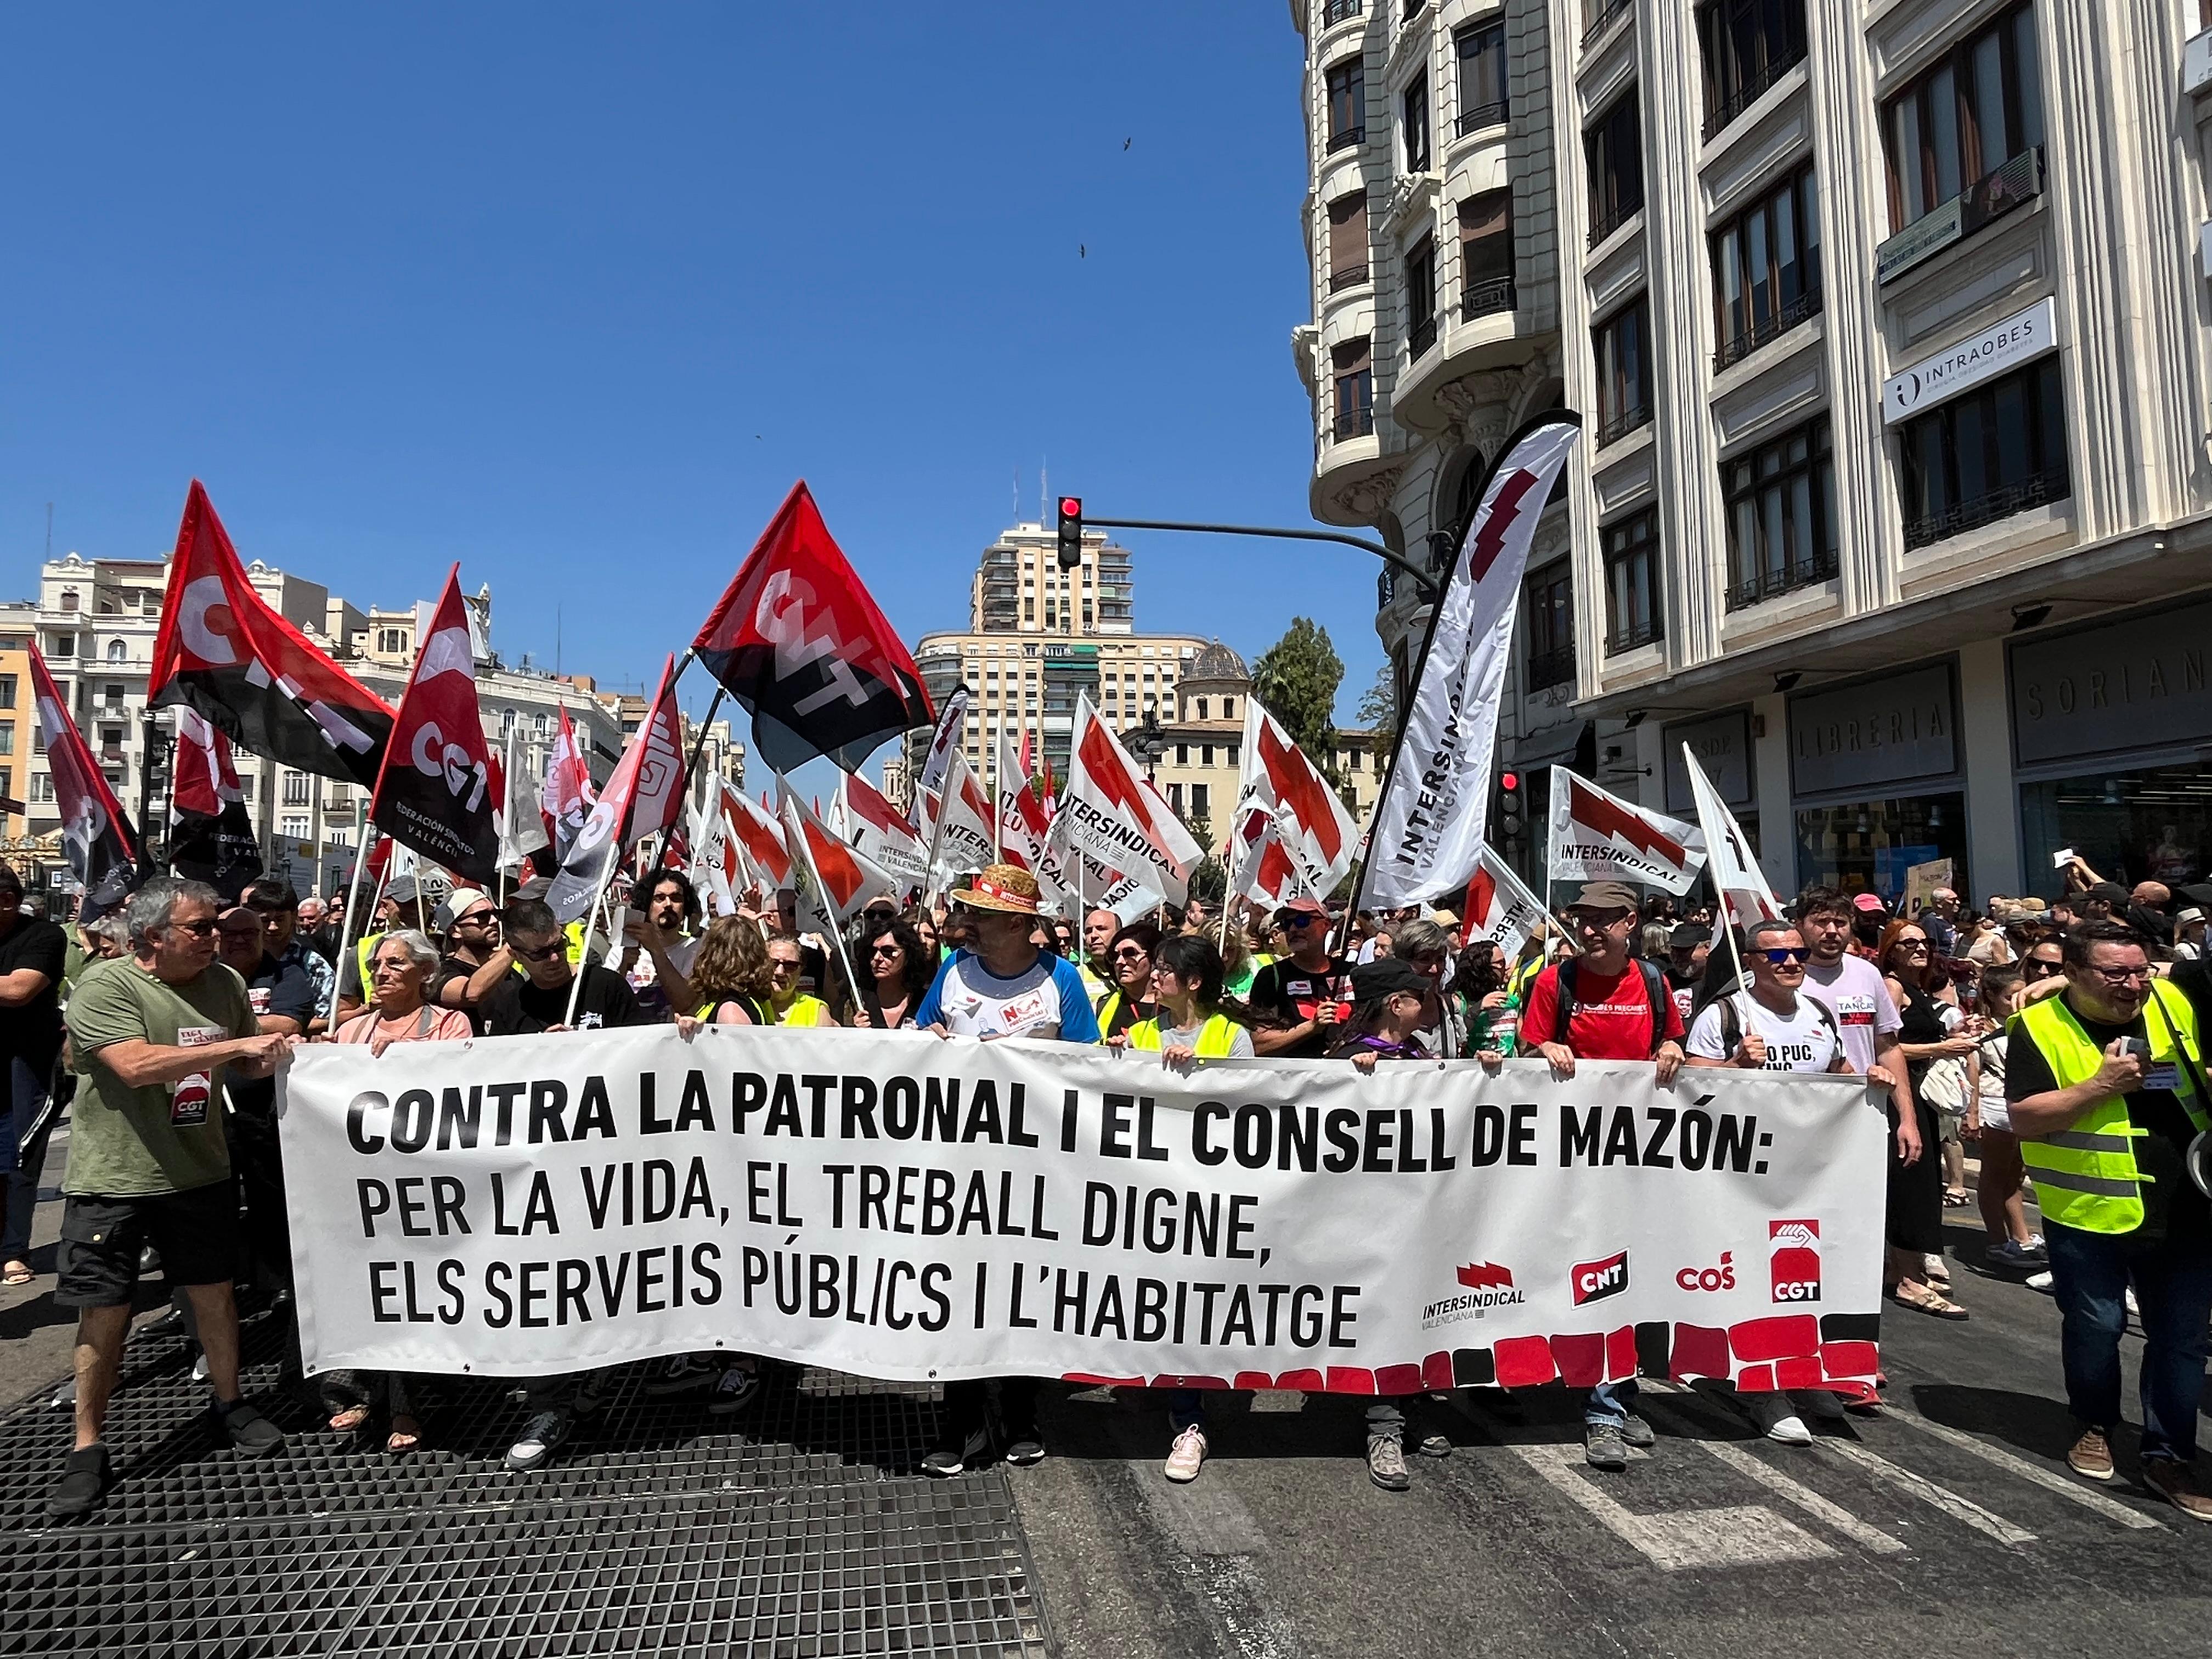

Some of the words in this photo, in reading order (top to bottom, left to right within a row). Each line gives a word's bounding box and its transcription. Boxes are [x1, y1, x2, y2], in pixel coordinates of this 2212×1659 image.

[1926, 320, 2033, 384] INTRAOBES
[2027, 649, 2206, 721] SORIAN
[1798, 703, 1944, 760] LIBRERIA
[1561, 843, 1678, 884] INTERSINDICAL
[1782, 1045, 1816, 1062] PUC,
[178, 1100, 206, 1111] CGT
[347, 1075, 618, 1154] CONTRA
[640, 1070, 716, 1135] LA
[732, 1072, 1039, 1149] PATRONAL
[1060, 1090, 1079, 1153] I
[1099, 1092, 1169, 1162] EL
[1192, 1101, 1456, 1173] CONSELL
[1471, 1104, 1538, 1167] DE
[1559, 1094, 1773, 1175] MAZÓN:
[357, 1176, 472, 1238] PER
[490, 1170, 560, 1236] LA
[580, 1156, 729, 1230] VIDA,
[747, 1161, 803, 1227] EL
[822, 1164, 1059, 1241] TREBALL
[1082, 1181, 1271, 1268] DIGNE,
[369, 1259, 465, 1325] ELS
[483, 1242, 722, 1329] SERVEIS
[742, 1234, 952, 1332] PÚBLICS
[974, 1262, 987, 1329] I
[1009, 1262, 1361, 1348] L'HABITATGE
[1580, 1264, 1622, 1293] CNT
[1775, 1282, 1818, 1300] CGT
[1421, 1310, 1475, 1331] VALENCIANA
[1423, 1290, 1525, 1320] INTERSINDICAL
